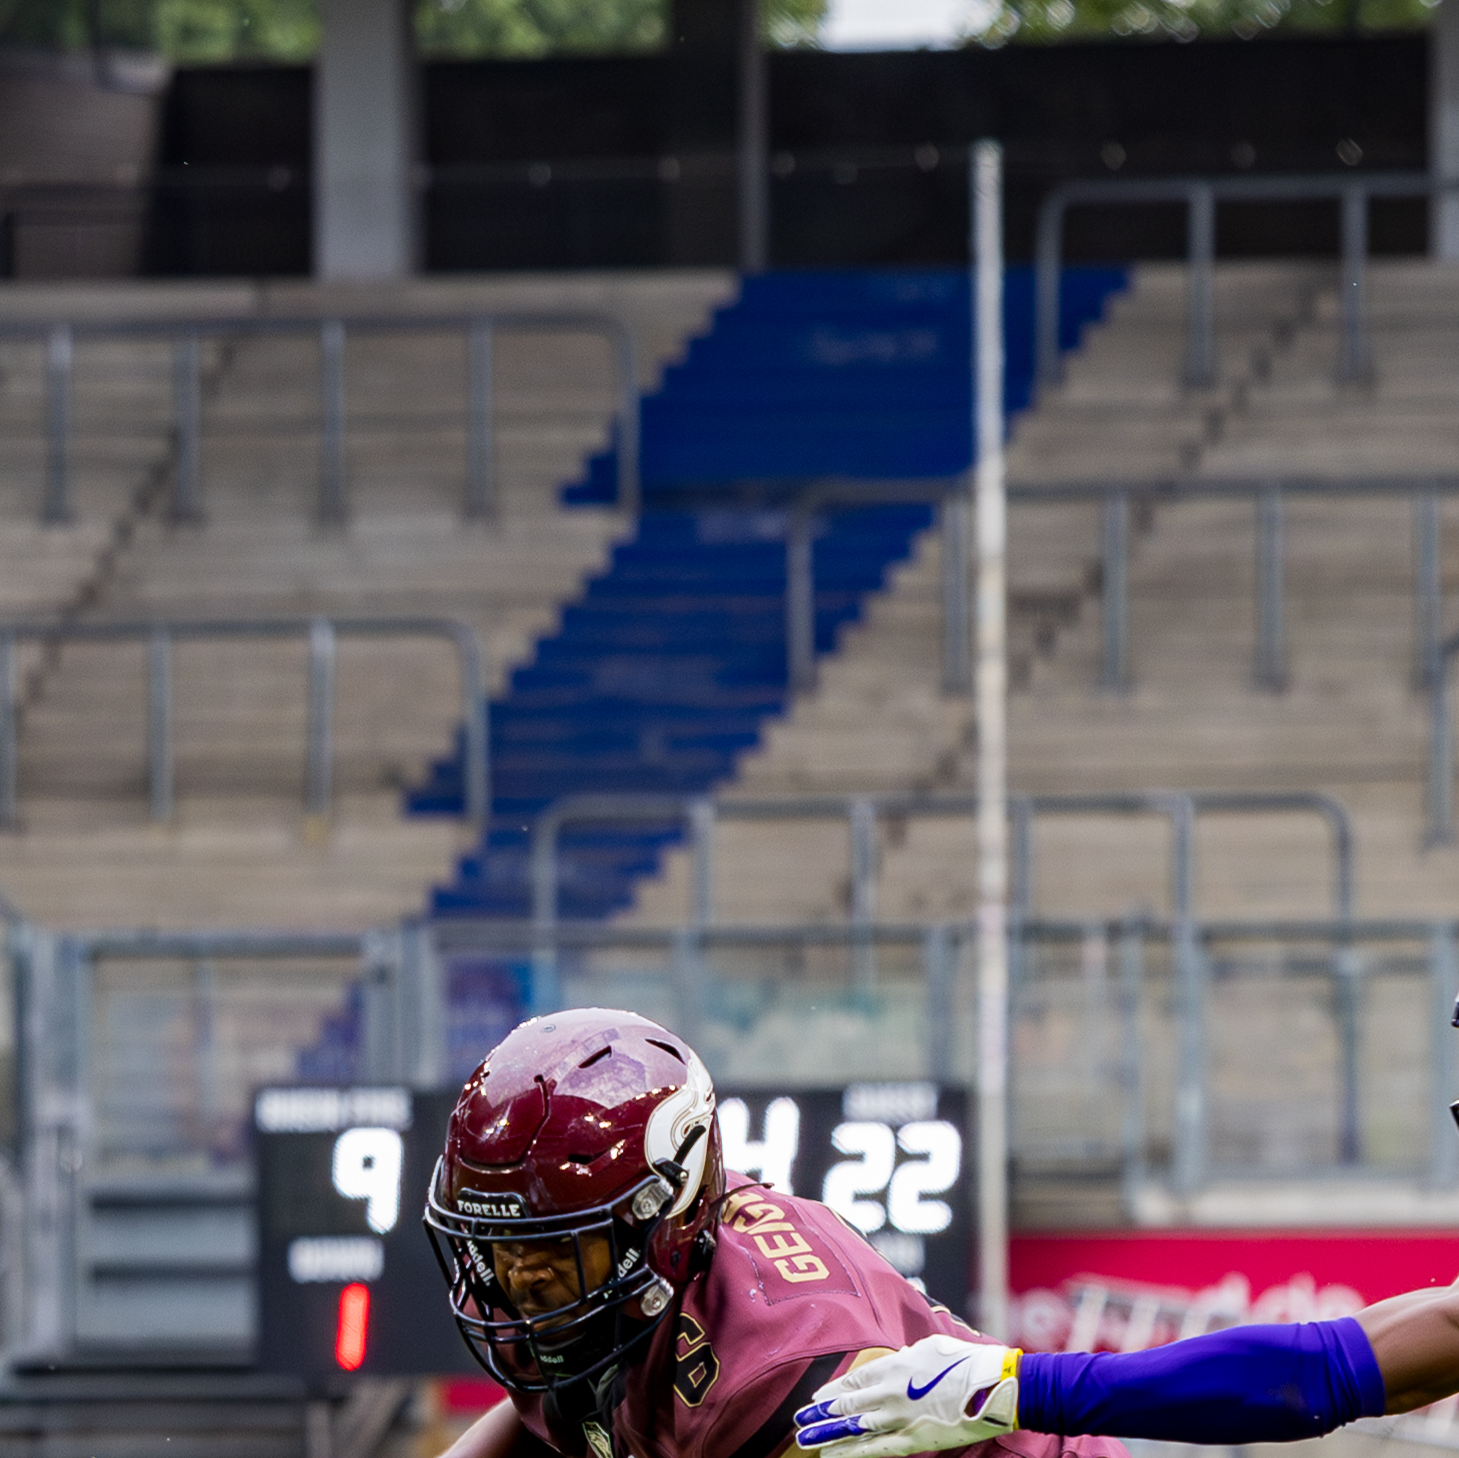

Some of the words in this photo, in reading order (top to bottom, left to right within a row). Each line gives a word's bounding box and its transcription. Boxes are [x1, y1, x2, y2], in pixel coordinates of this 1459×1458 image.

[332, 1127, 404, 1234] 9
[716, 1097, 800, 1197] 4
[822, 1121, 962, 1234] 22
[457, 1200, 520, 1217] FORELLE
[336, 1283, 370, 1371] 1
[673, 1312, 721, 1408] 6
